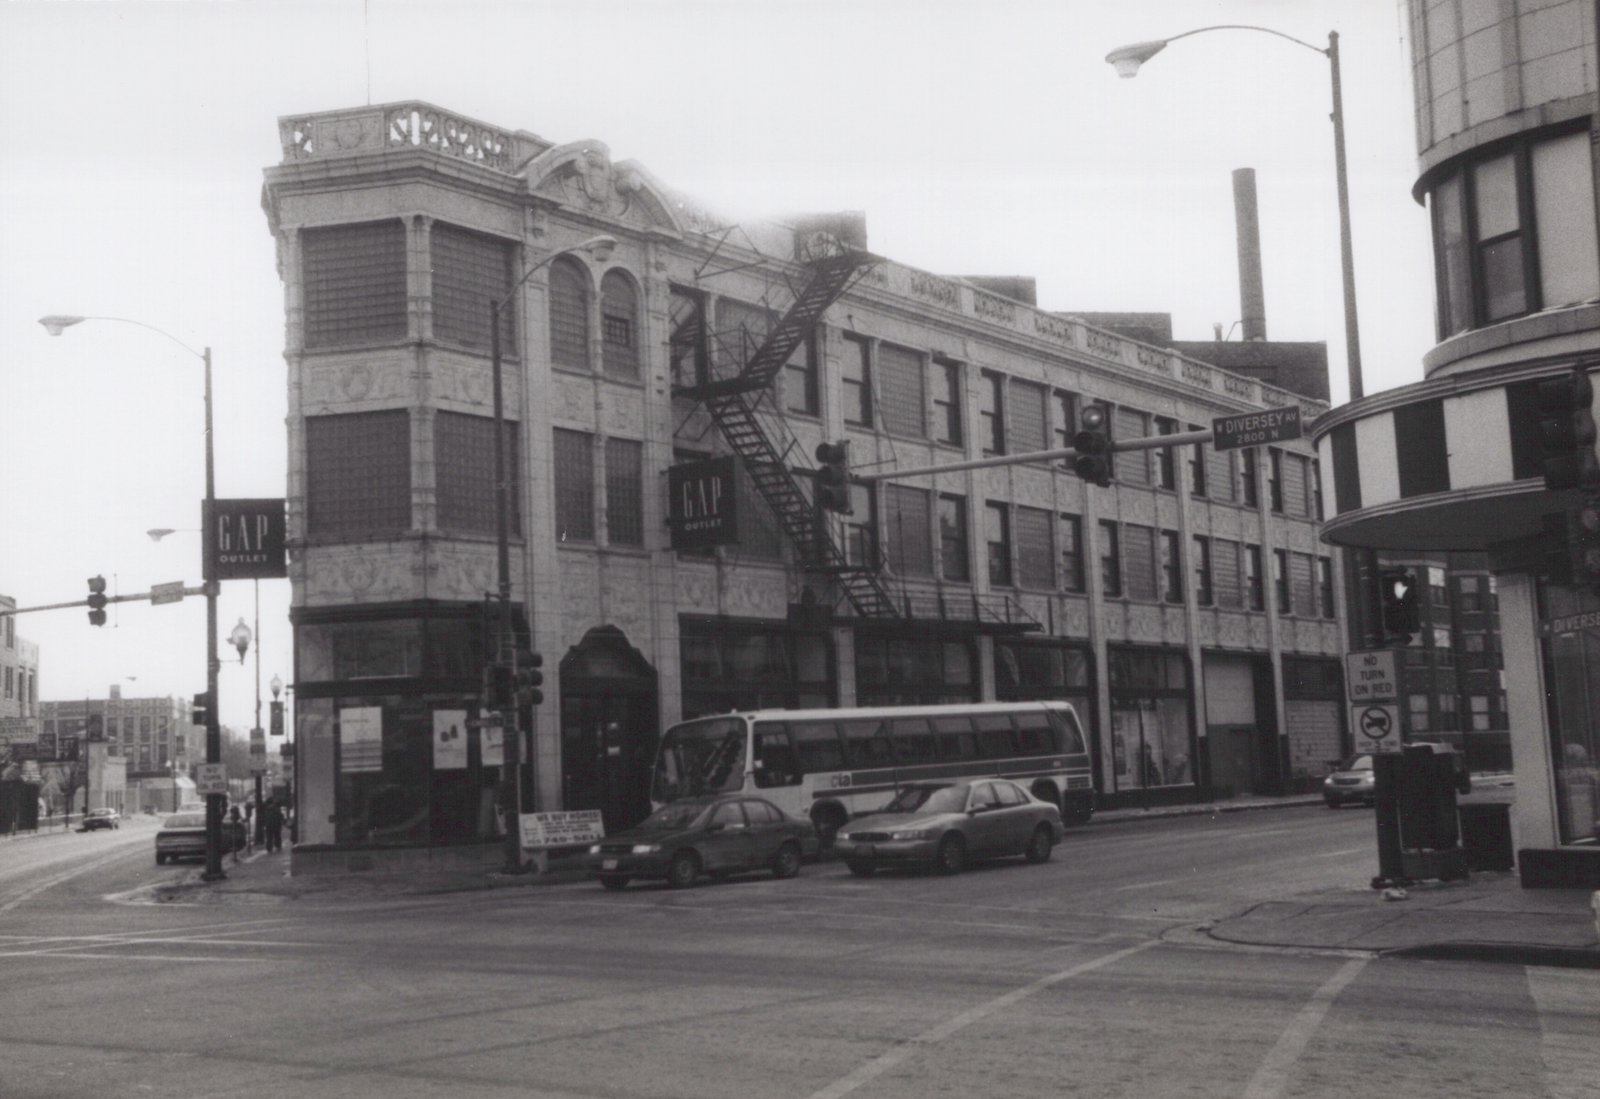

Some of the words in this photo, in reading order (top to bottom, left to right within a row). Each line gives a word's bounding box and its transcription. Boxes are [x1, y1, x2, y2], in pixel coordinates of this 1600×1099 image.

[1225, 413, 1284, 434] DIVERSEY
[1286, 411, 1297, 422] AV
[1237, 431, 1265, 444] 2800
[1271, 430, 1279, 439] N
[683, 476, 721, 518] GAP
[685, 518, 721, 531] OUTLET
[219, 514, 268, 551] GAP
[219, 554, 268, 564] OUTLET
[1364, 656, 1377, 666] NO
[1360, 670, 1385, 681] TURN
[1354, 685, 1368, 695] ON
[1372, 682, 1392, 694] RED
